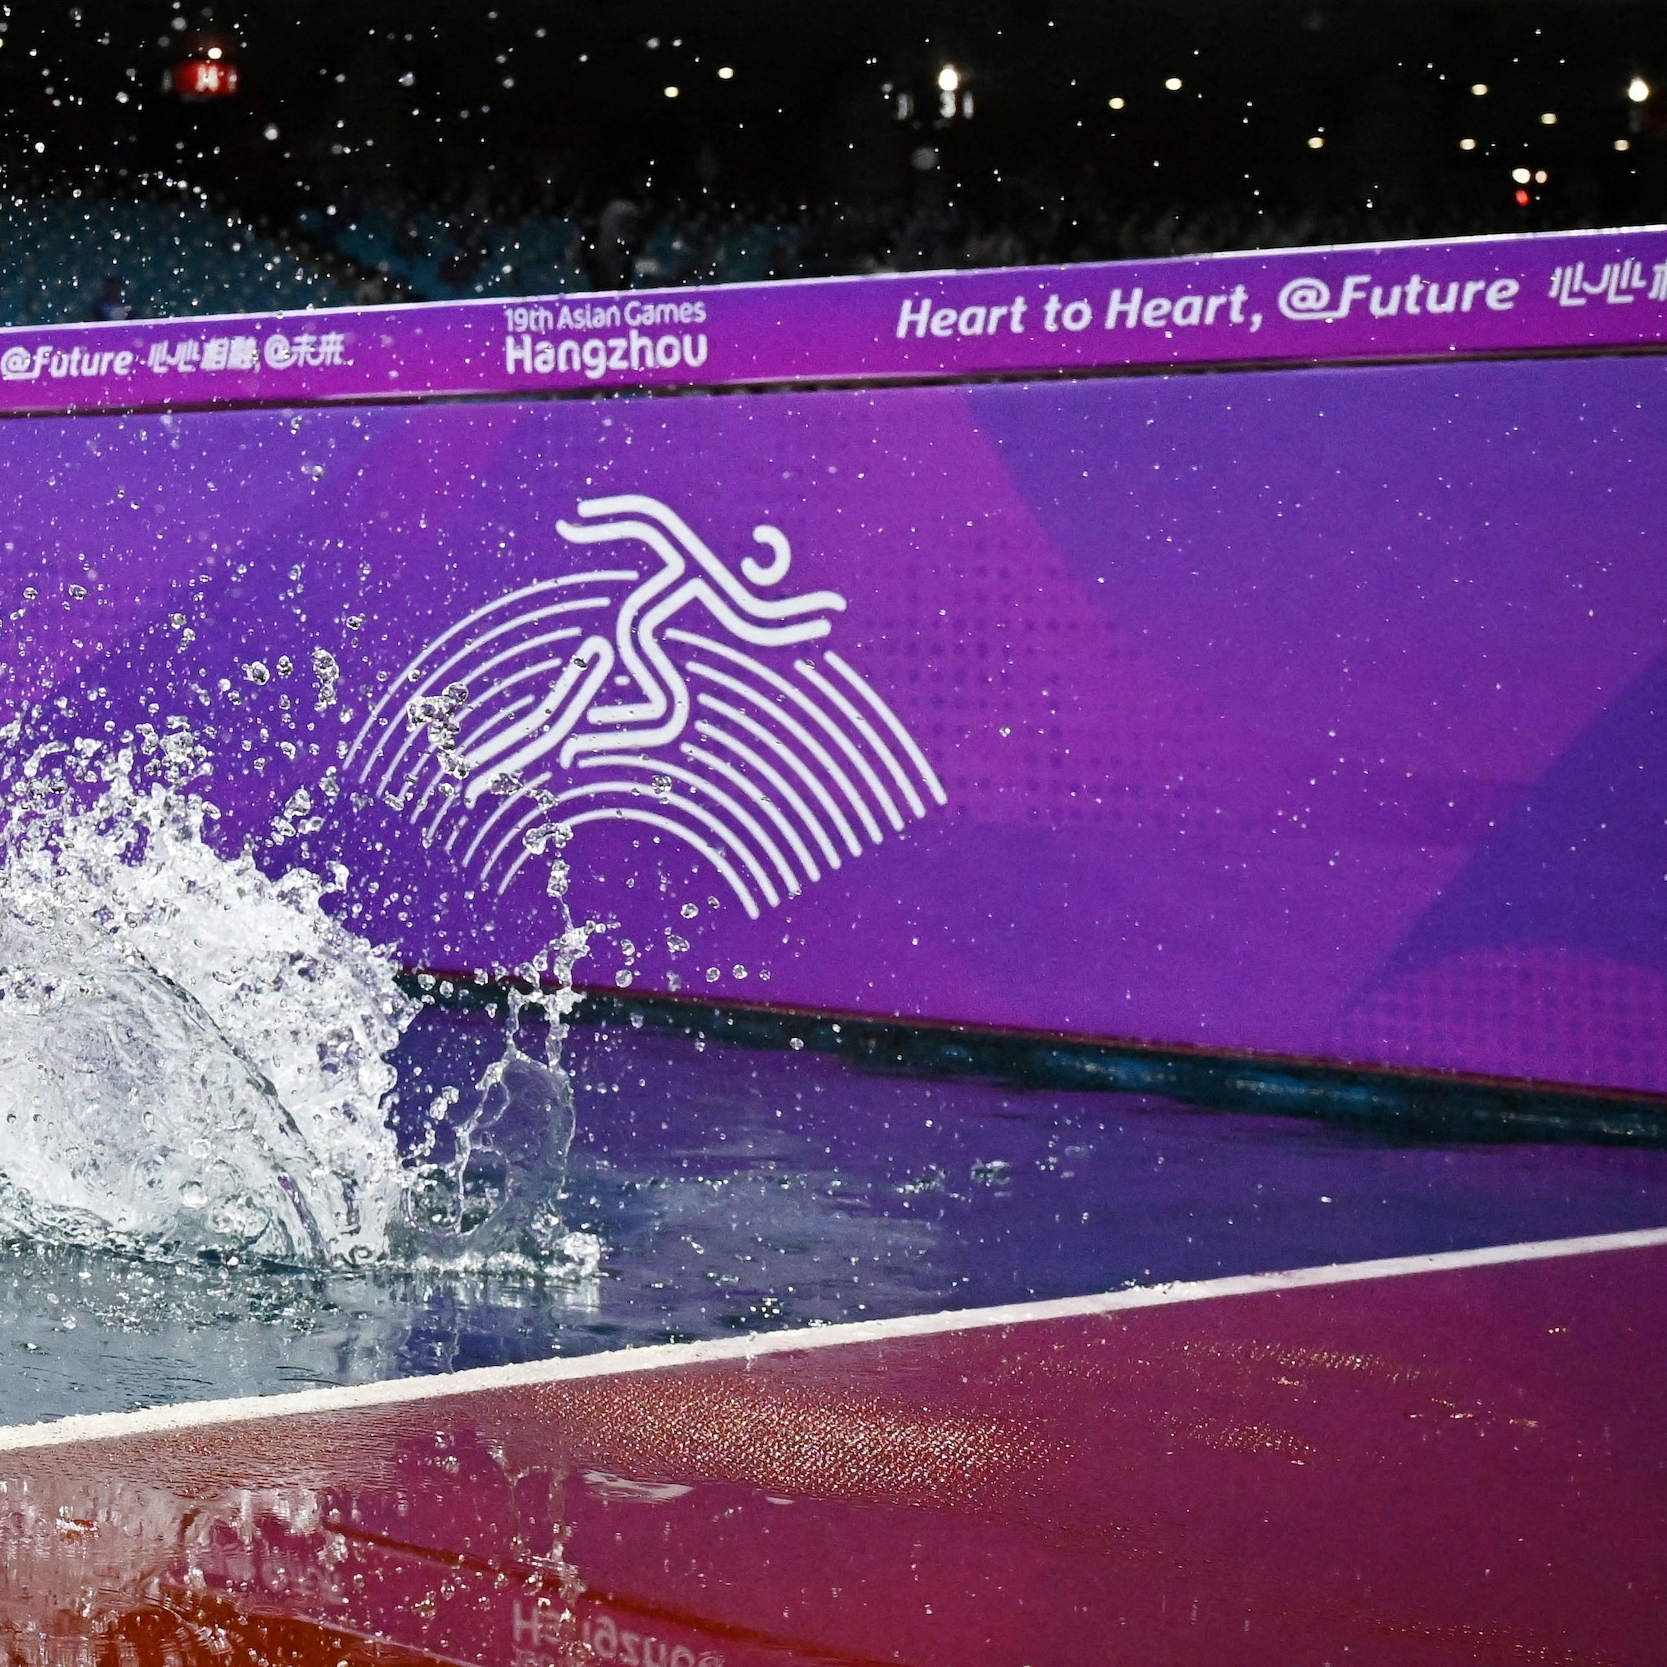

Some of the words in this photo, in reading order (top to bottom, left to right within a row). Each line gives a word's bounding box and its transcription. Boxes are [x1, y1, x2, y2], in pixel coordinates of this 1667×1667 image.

[504, 307, 553, 332] 19th
[557, 304, 620, 329] Asian
[624, 301, 707, 326] Games
[896, 296, 1026, 339] Heart
[1043, 295, 1091, 332] to
[1105, 285, 1264, 333] Heart,
[1279, 274, 1519, 320] @Future
[1, 345, 133, 380] @Future
[505, 329, 708, 380] Hangzhou
